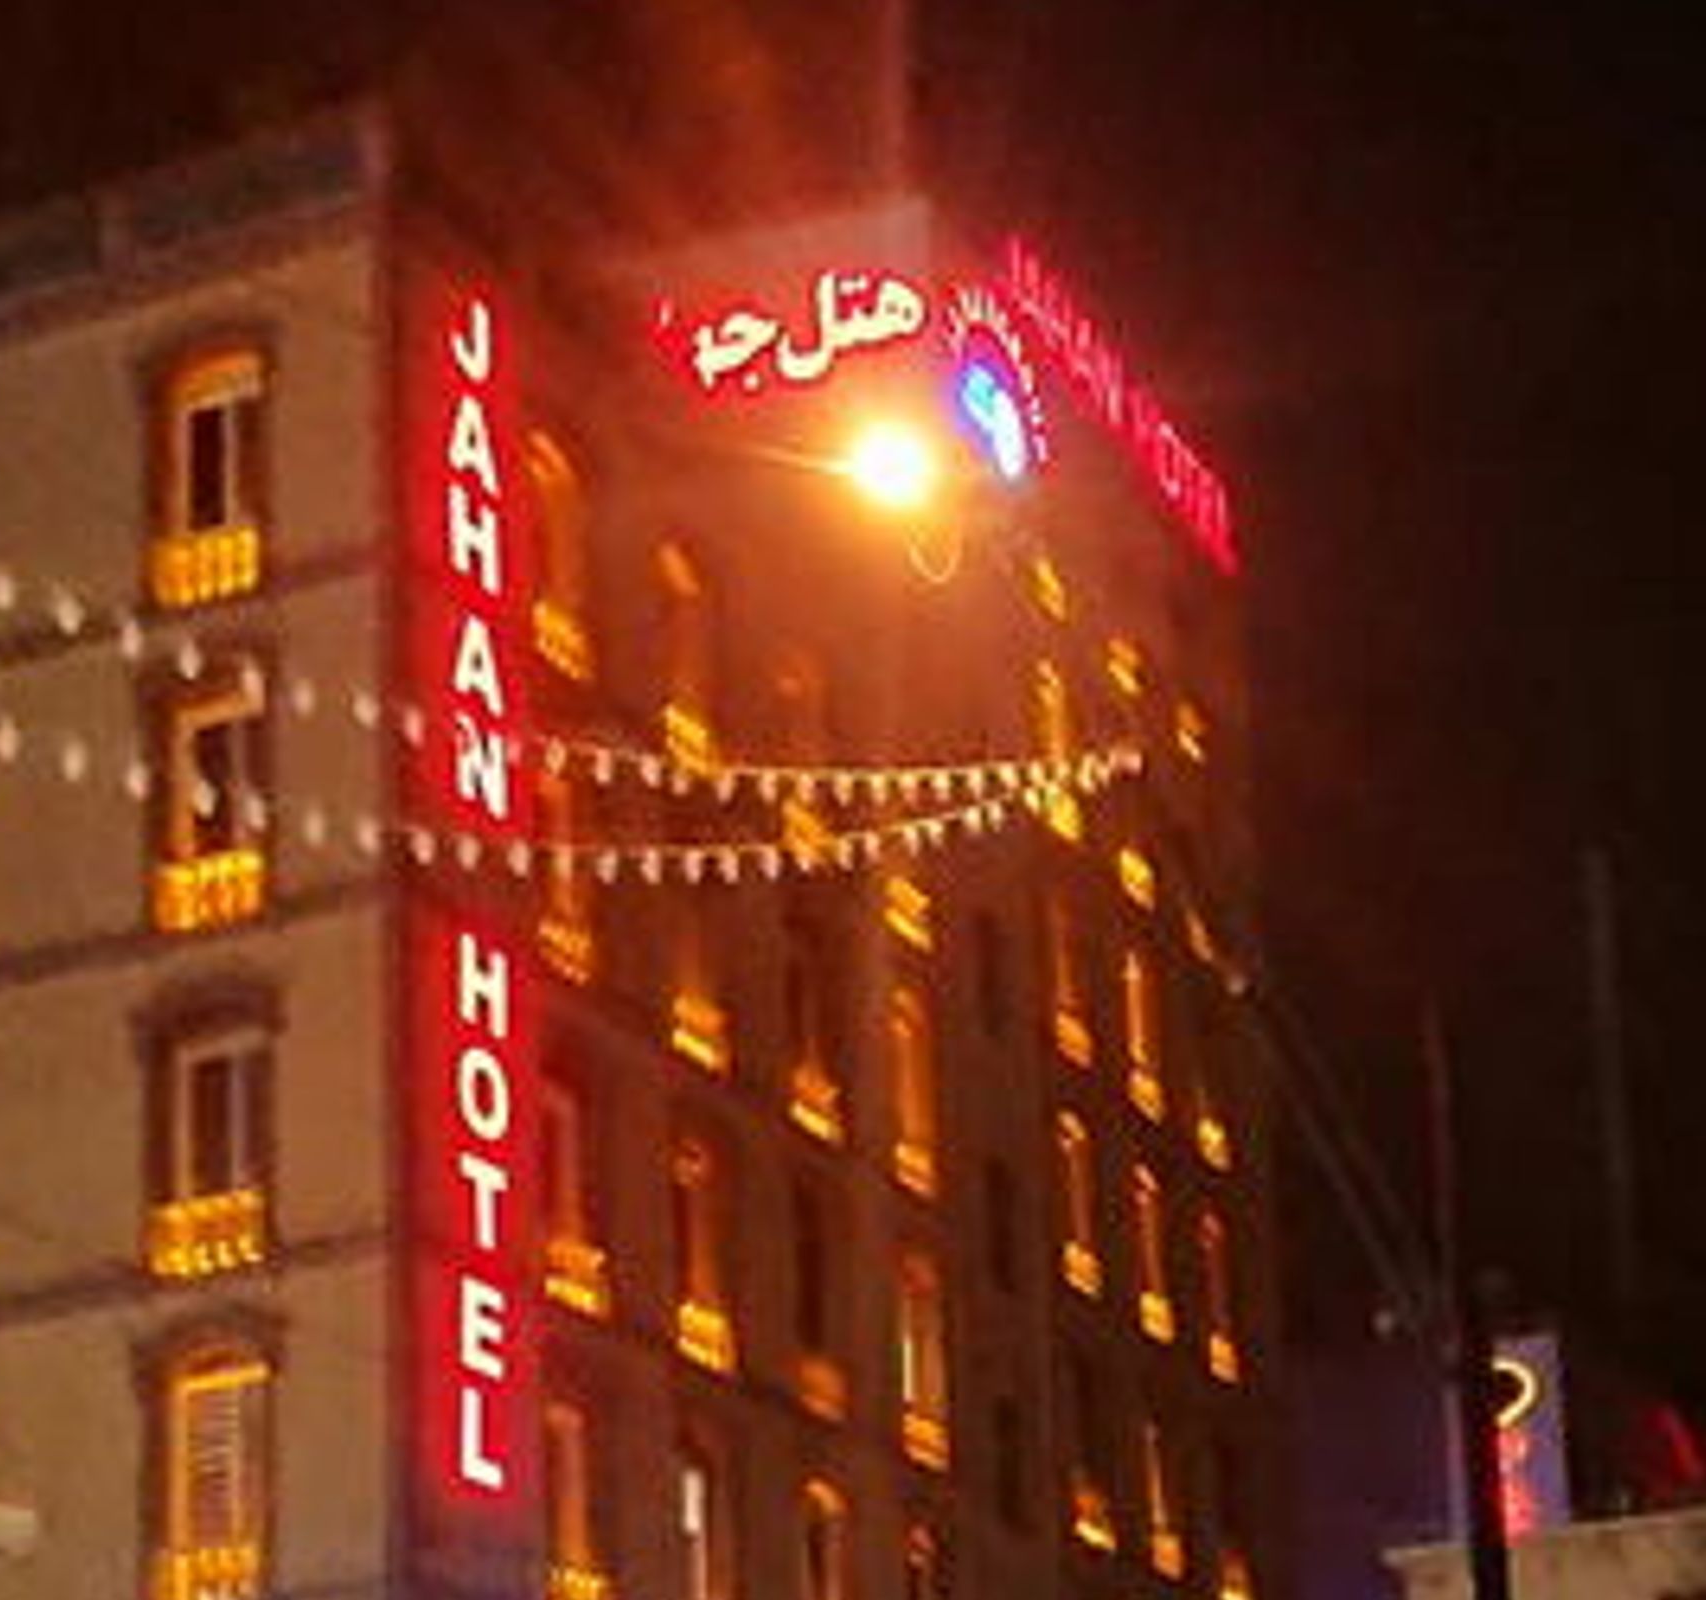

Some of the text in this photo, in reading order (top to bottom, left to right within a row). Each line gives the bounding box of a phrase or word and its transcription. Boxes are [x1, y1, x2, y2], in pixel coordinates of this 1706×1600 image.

[659, 300, 779, 391] جه
[777, 272, 925, 380] هتل
[447, 300, 510, 1488] JAHAN HOTEL
